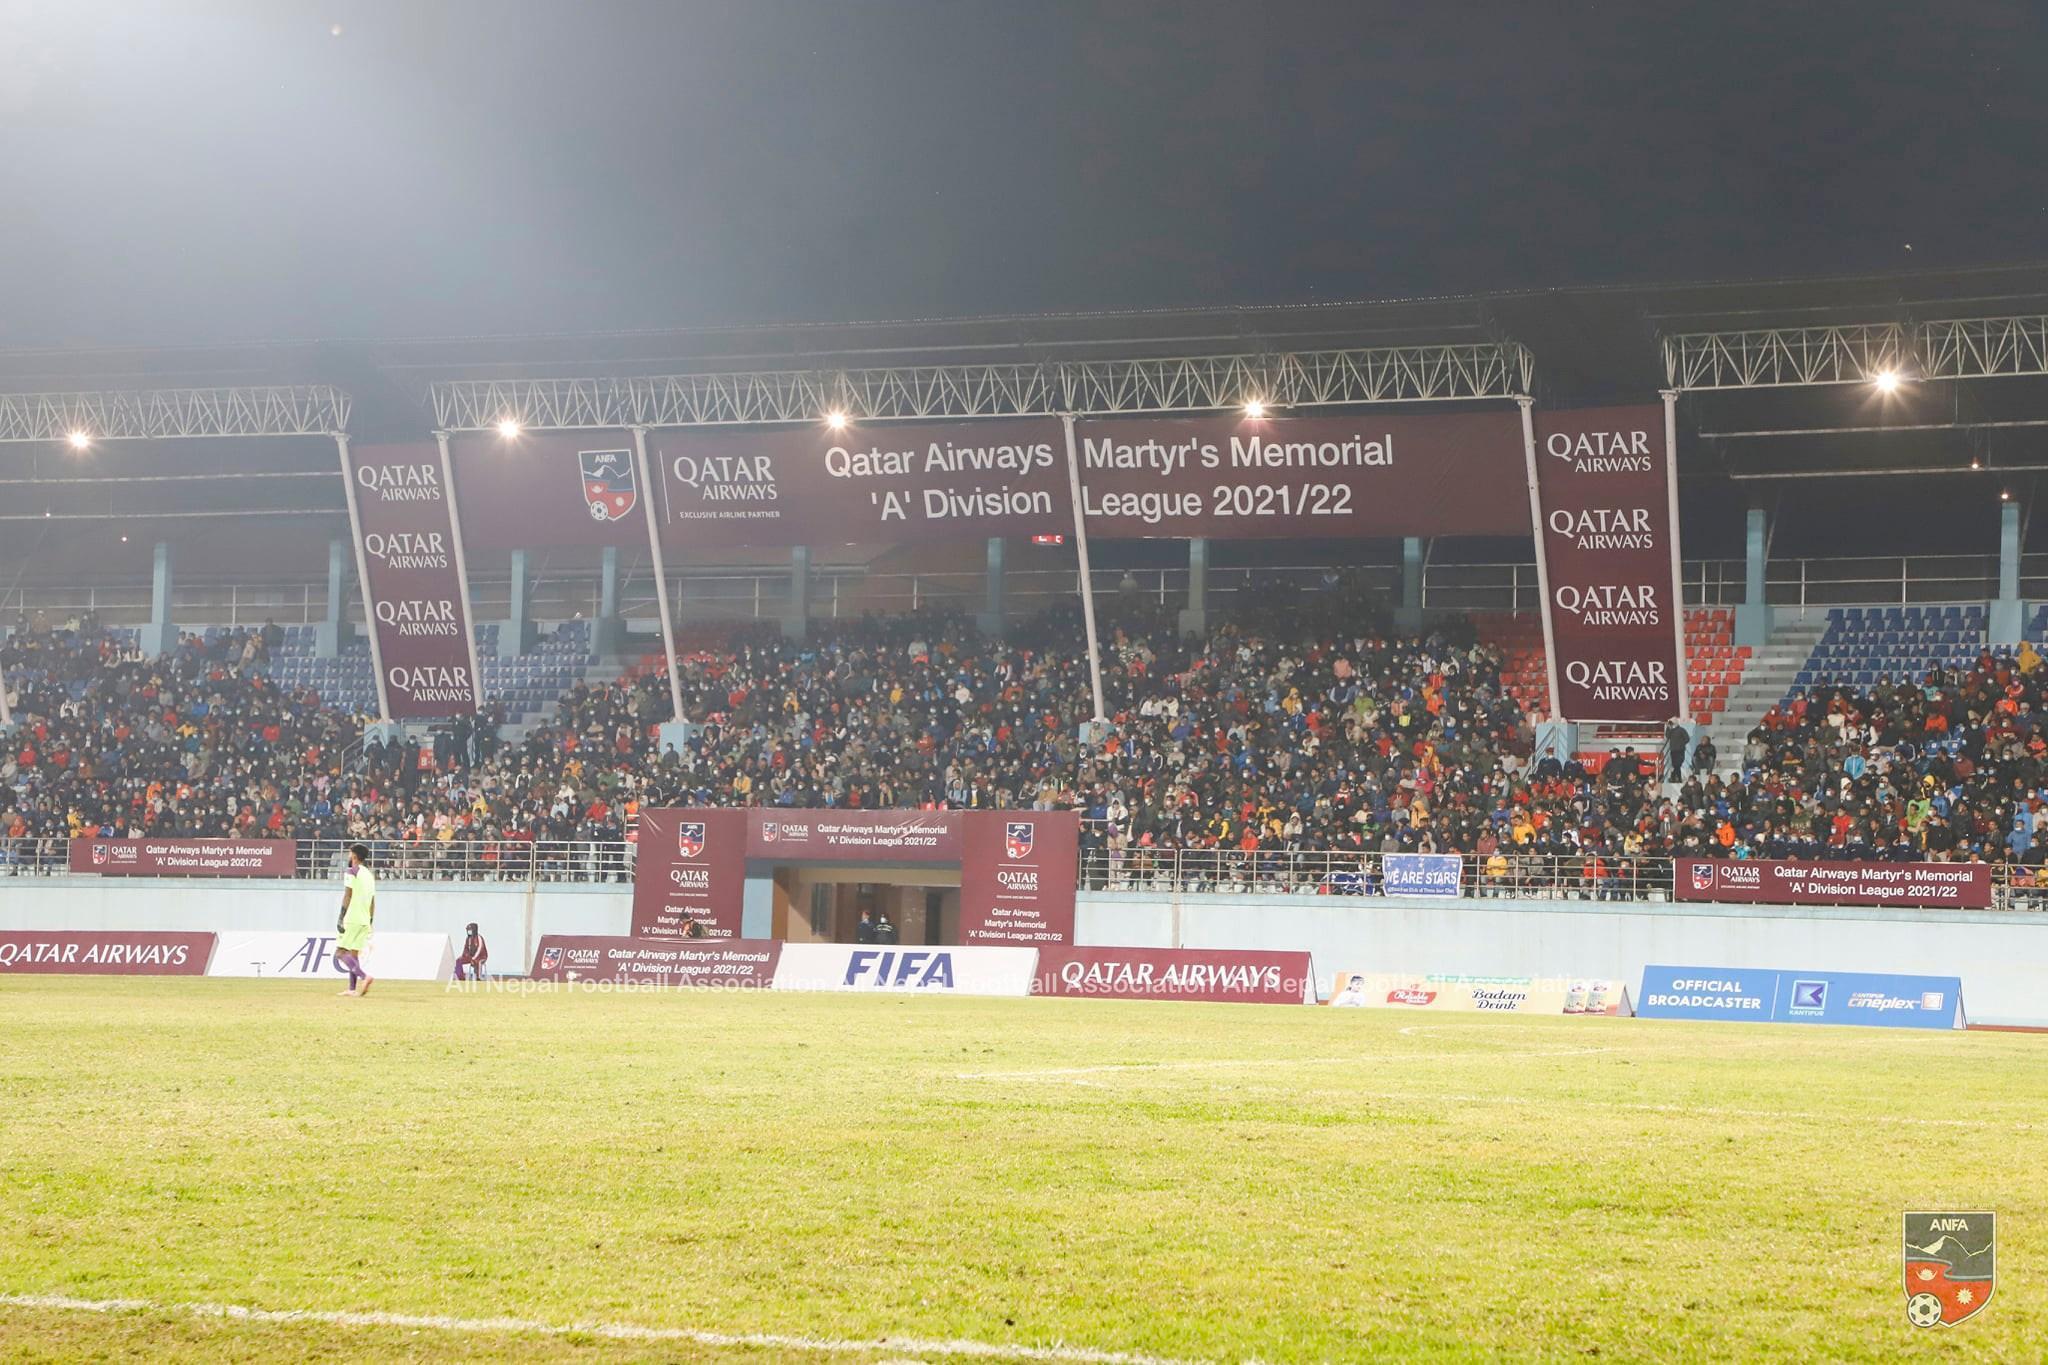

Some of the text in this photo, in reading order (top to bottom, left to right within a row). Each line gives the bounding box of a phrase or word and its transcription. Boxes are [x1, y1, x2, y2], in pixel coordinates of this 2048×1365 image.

[1548, 431, 1650, 462] QATAR
[824, 434, 1393, 478] Qatar Airways Martyr's Memorial
[1575, 457, 1652, 472] AIRWAYS
[358, 464, 436, 490] QATAR
[674, 456, 775, 488] QATAR
[381, 487, 440, 501] AIRWAYS
[702, 484, 777, 500] AIRWAYS
[871, 483, 1352, 523] 'A' Division League 2021/22
[680, 511, 718, 519] EXCLUSIVE
[719, 511, 746, 519] AIRLINE
[1550, 509, 1652, 538] QATAR
[366, 533, 444, 558] QATAR
[1578, 534, 1653, 549] AIRWAYS
[388, 555, 447, 569] AIRWAYS
[1556, 586, 1658, 614] QATAR
[376, 600, 455, 626] QATAR
[1584, 610, 1658, 625] AIRWAYS
[400, 622, 458, 636] AIRWAYS
[390, 667, 469, 691] QATAR
[1566, 661, 1667, 689] QATAR
[413, 688, 472, 702] AIRWAYS
[1594, 686, 1668, 700] AIRWAYS
[782, 824, 808, 834] QATAR
[818, 824, 946, 835] Qatar Airways Martyr's Memorial
[827, 836, 936, 846] 'A' Division League 2021/22
[112, 846, 136, 856] QATAR
[146, 845, 272, 856] Qatar Airways Martyr's Memorial
[156, 858, 262, 868] 'A' Division League 2021/22
[670, 870, 708, 882] QATAR
[998, 872, 1038, 884] QATAR
[1385, 870, 1456, 885] WE ARE STARS
[1721, 866, 1760, 878] QATAR
[1774, 866, 1972, 883] Qatar Airways Martyr's Memorial
[680, 880, 708, 888] AIRWAYS
[1007, 883, 1038, 891] AIRWAYS
[1789, 882, 1957, 898] 'A' Division League 2021/22
[665, 906, 710, 915] Qatar Airways
[992, 908, 1040, 918] Qatar Airways
[642, 926, 650, 934] 'A'
[652, 926, 678, 935] Division
[984, 920, 1046, 929] Martyr's Memorial
[968, 930, 1062, 942] 'A' Division League 2021/22
[0, 943, 188, 964] QATAR AIRWAYS
[568, 949, 600, 960] QATAR
[608, 948, 770, 962] Qatar Airways Martyr's Memorial
[617, 962, 753, 975] 'A' Division League 2021/22
[843, 951, 954, 988] FIFA
[1062, 962, 1281, 988] QATAR AIRWAYS
[1672, 980, 1742, 993] OFFICIAL
[1472, 990, 1527, 1000] Badam
[1648, 994, 1761, 1009] BROADCASTER
[1476, 1000, 1518, 1010] Drink
[1848, 997, 1915, 1011] cineplex
